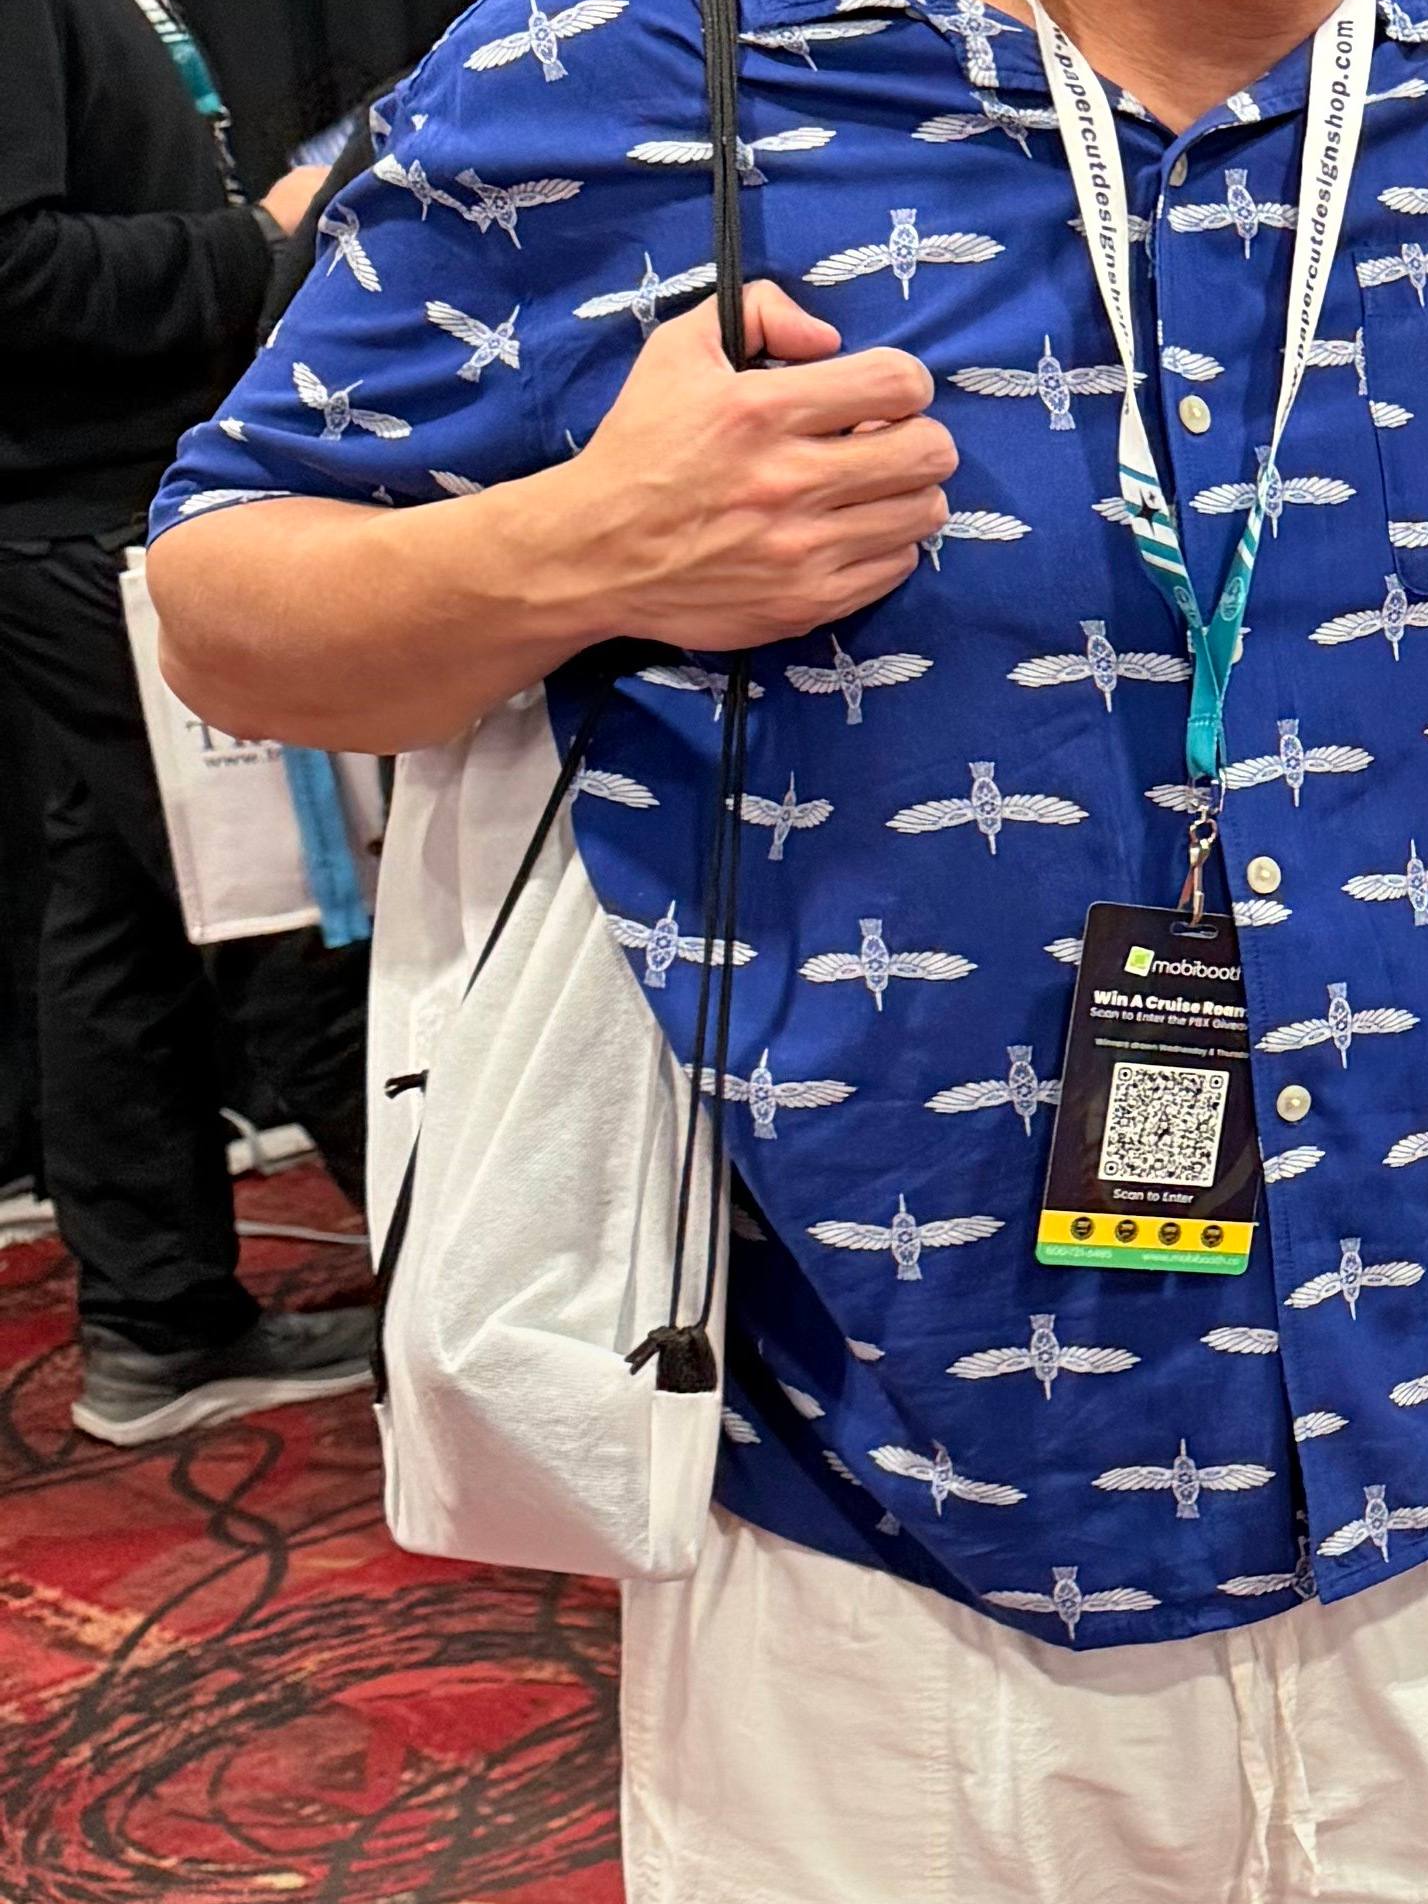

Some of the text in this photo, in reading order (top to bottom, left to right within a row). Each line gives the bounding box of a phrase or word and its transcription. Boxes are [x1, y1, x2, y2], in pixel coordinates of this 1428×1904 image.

[1093, 989, 1128, 1007] Win
[1130, 994, 1143, 1008] A
[1145, 996, 1201, 1014] Cruise
[1090, 1006, 1119, 1019] Scan
[1121, 1009, 1134, 1021] to
[1113, 1188, 1194, 1204] Scan to Enter
